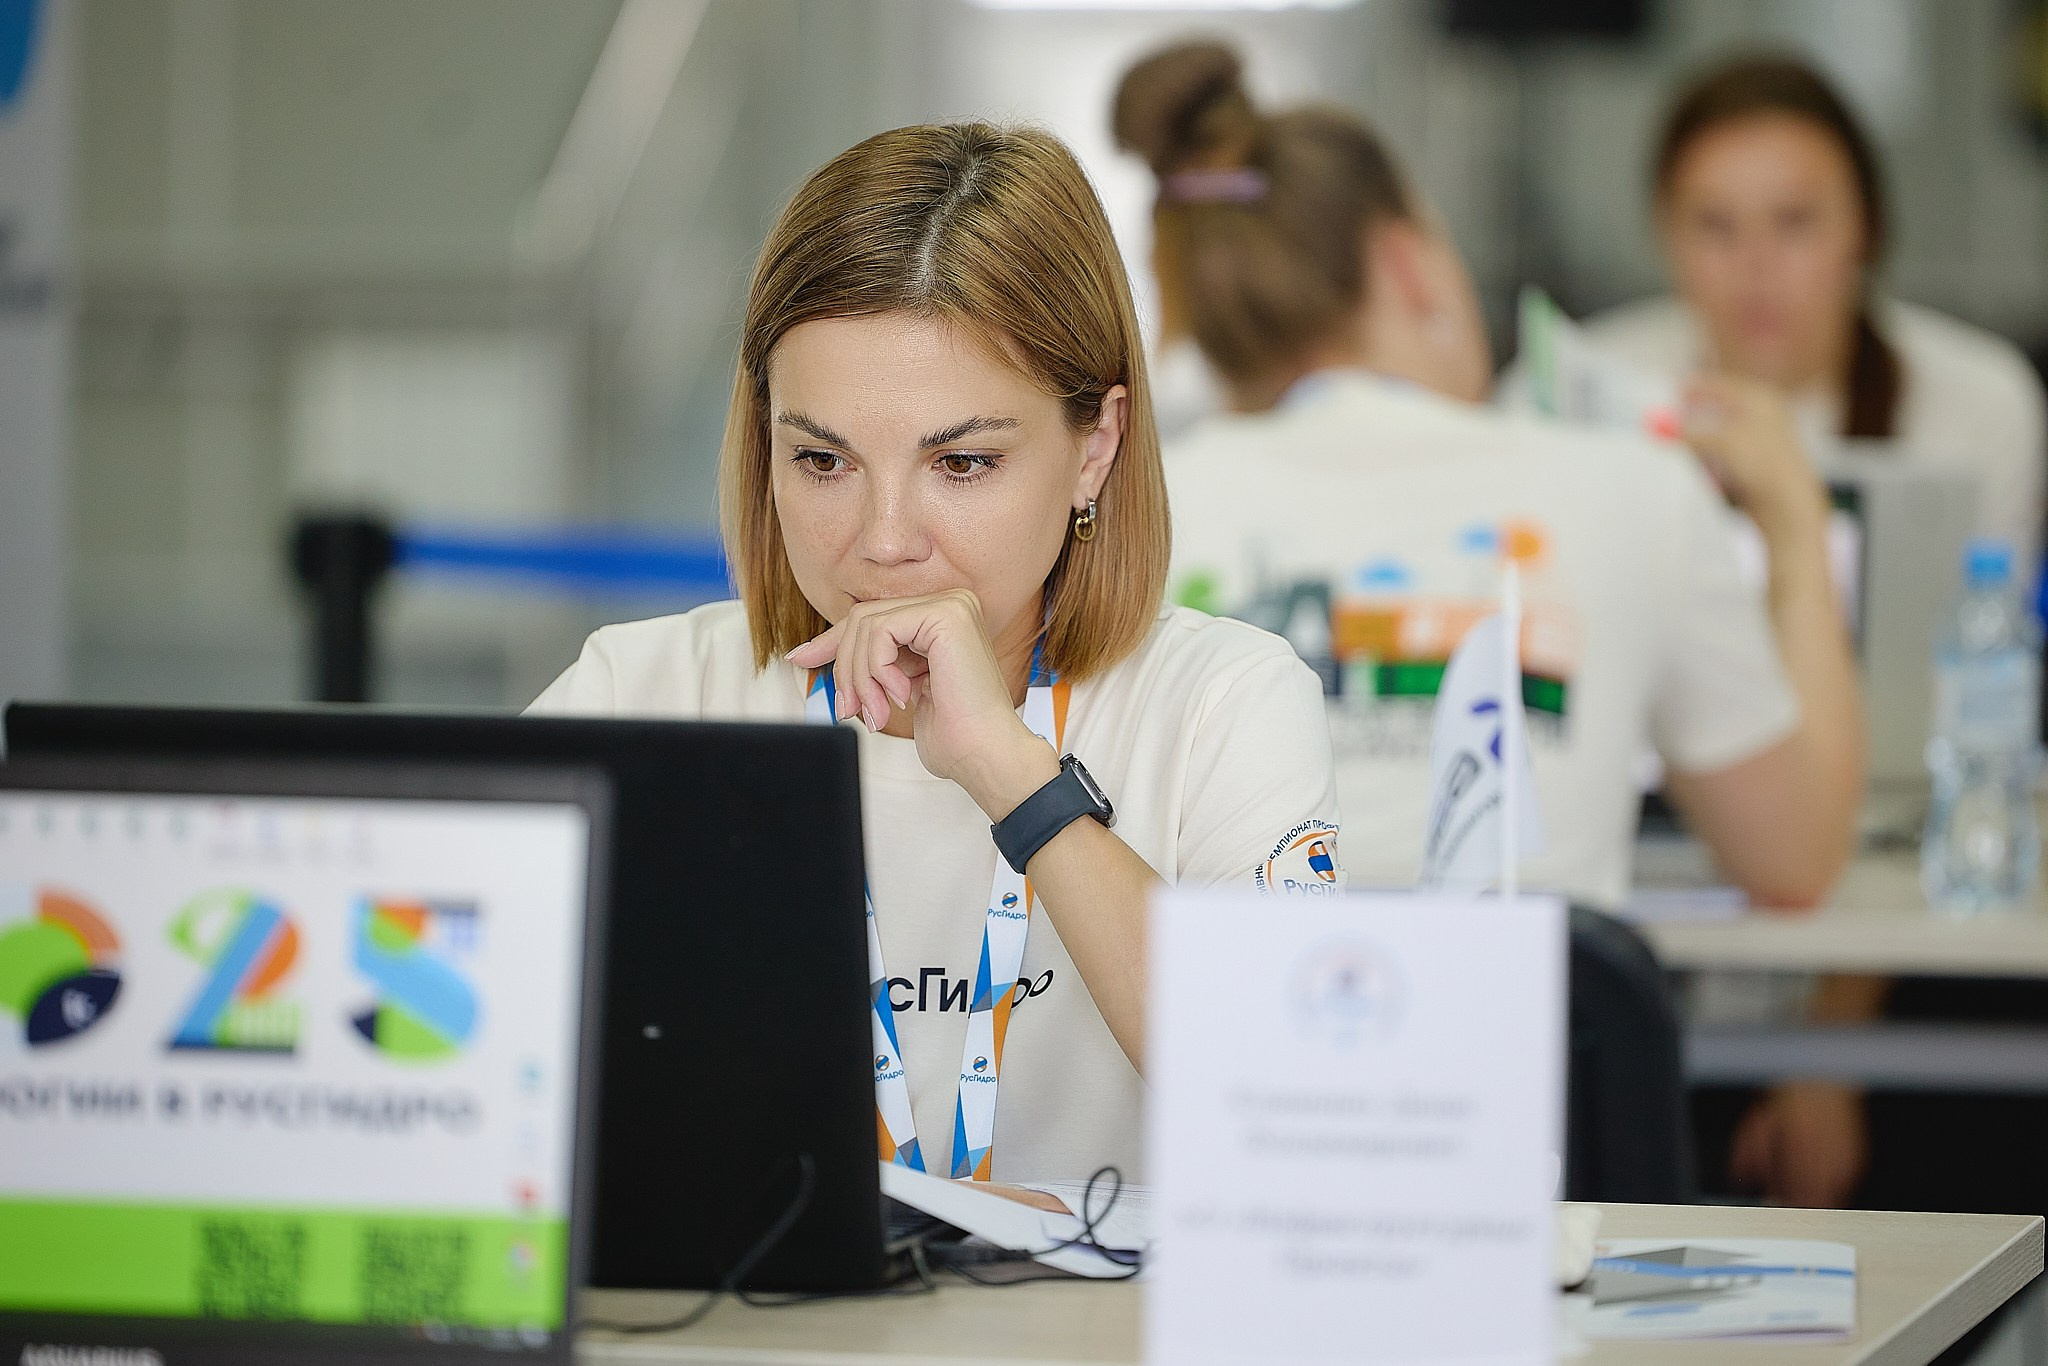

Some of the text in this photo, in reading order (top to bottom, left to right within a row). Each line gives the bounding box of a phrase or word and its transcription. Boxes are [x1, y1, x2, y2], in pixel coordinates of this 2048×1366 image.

[1267, 820, 1311, 861] ЕМПИОНАТ
[987, 908, 1027, 920] РусГидро
[875, 1070, 904, 1082] сГидро
[960, 1073, 996, 1083] РусГидро
